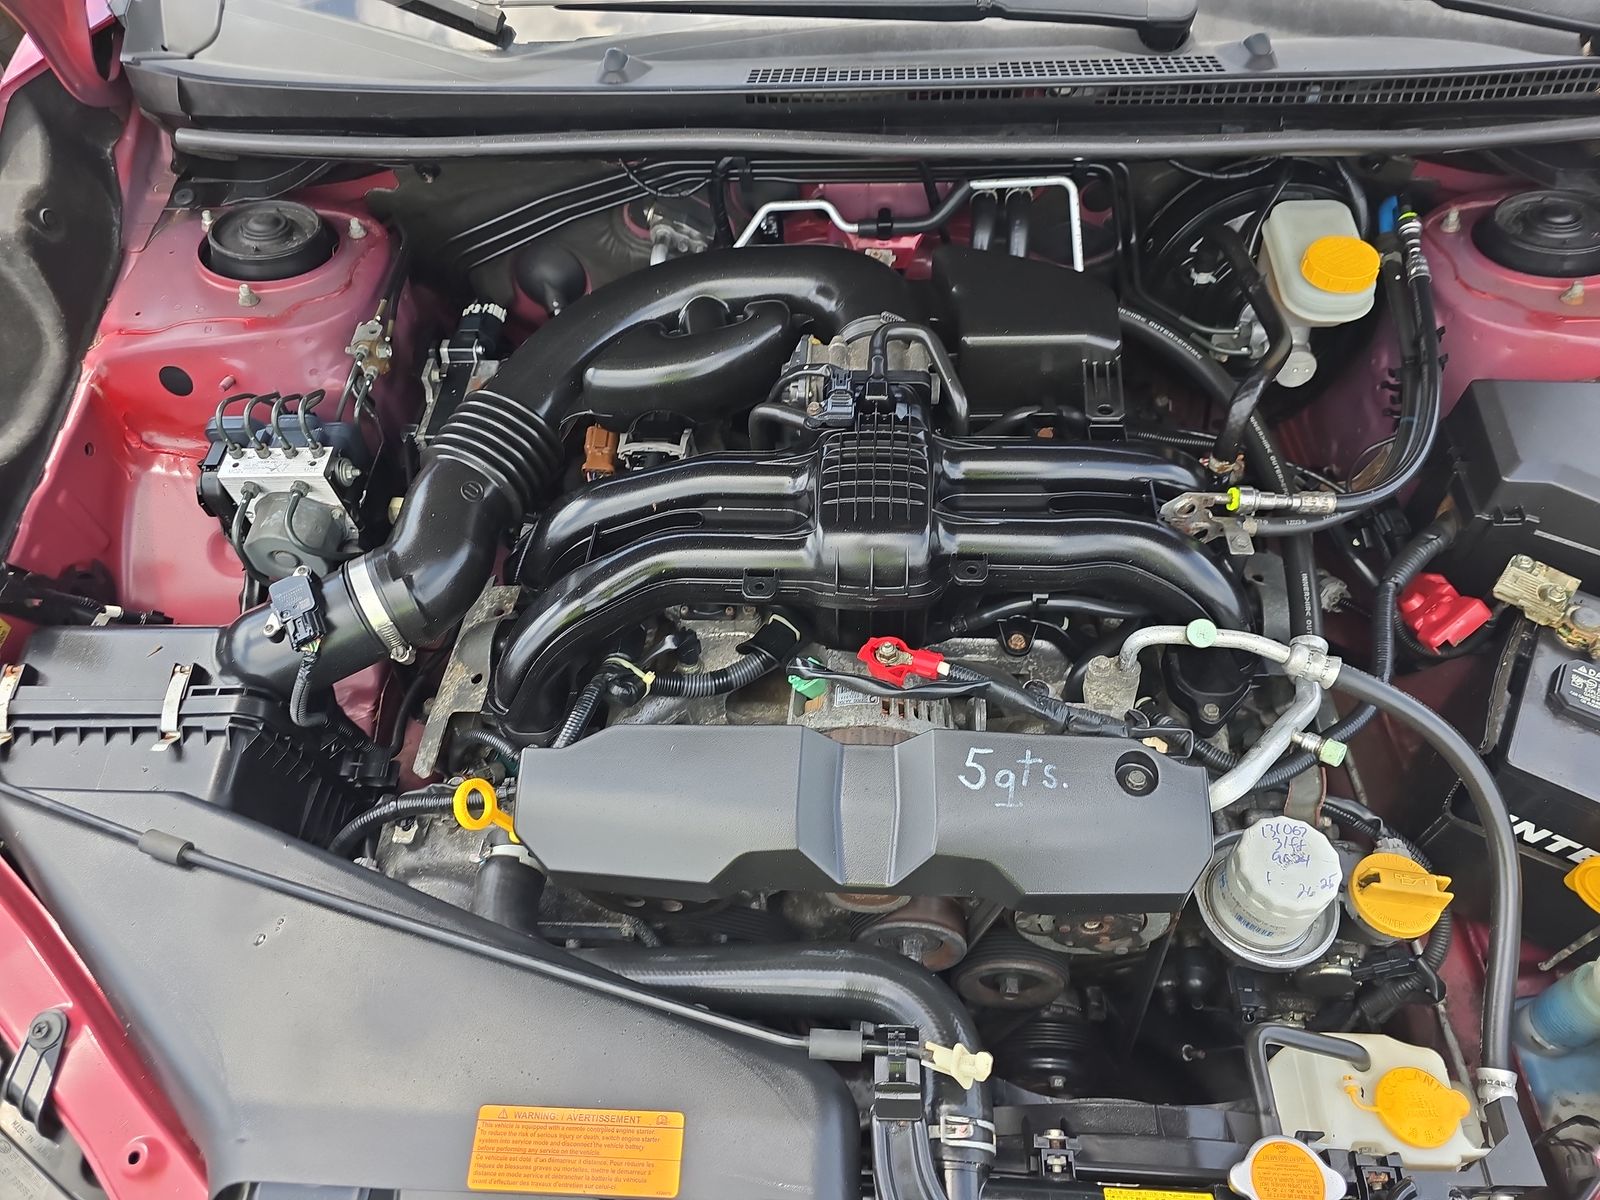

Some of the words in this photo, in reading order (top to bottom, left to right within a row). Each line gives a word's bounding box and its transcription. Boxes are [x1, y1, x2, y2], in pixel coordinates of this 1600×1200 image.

[513, 1111, 559, 1120] WARNING:
[566, 1113, 640, 1123] AVERTISSEMENT
[11, 1120, 27, 1136] MADE
